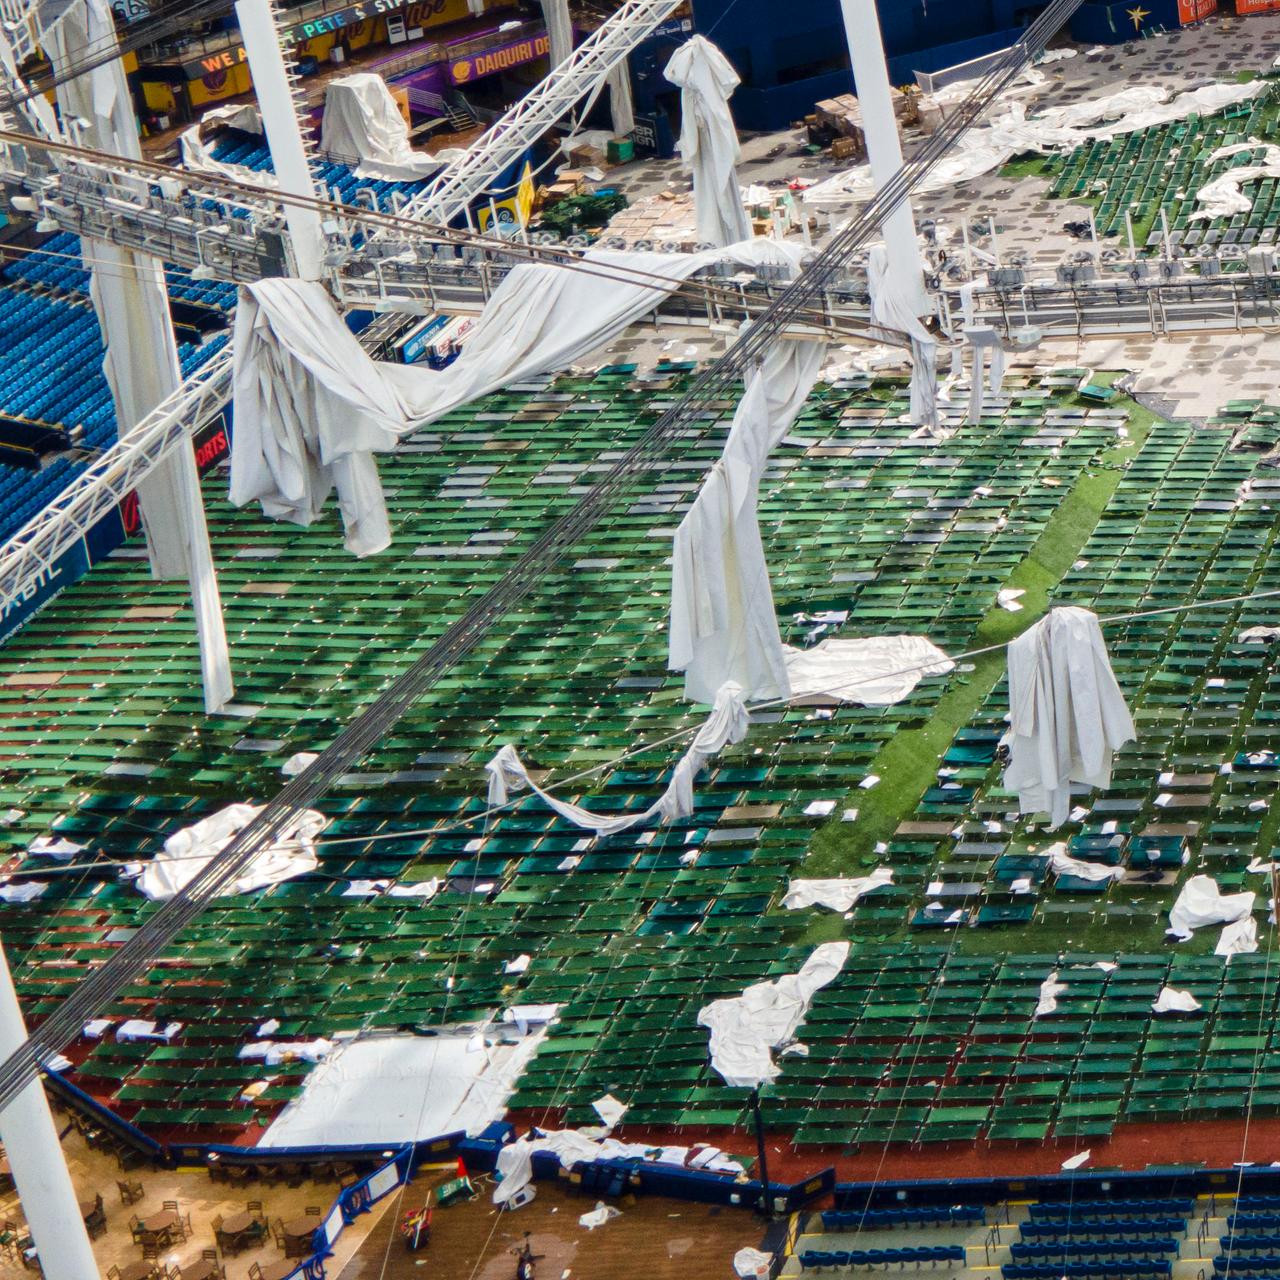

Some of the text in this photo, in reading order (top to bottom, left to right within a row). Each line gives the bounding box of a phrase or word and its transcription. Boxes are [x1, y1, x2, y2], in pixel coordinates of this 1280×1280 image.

[302, 13, 347, 39] PETE
[201, 52, 234, 73] WE
[475, 42, 533, 76] DAIQUIRI
